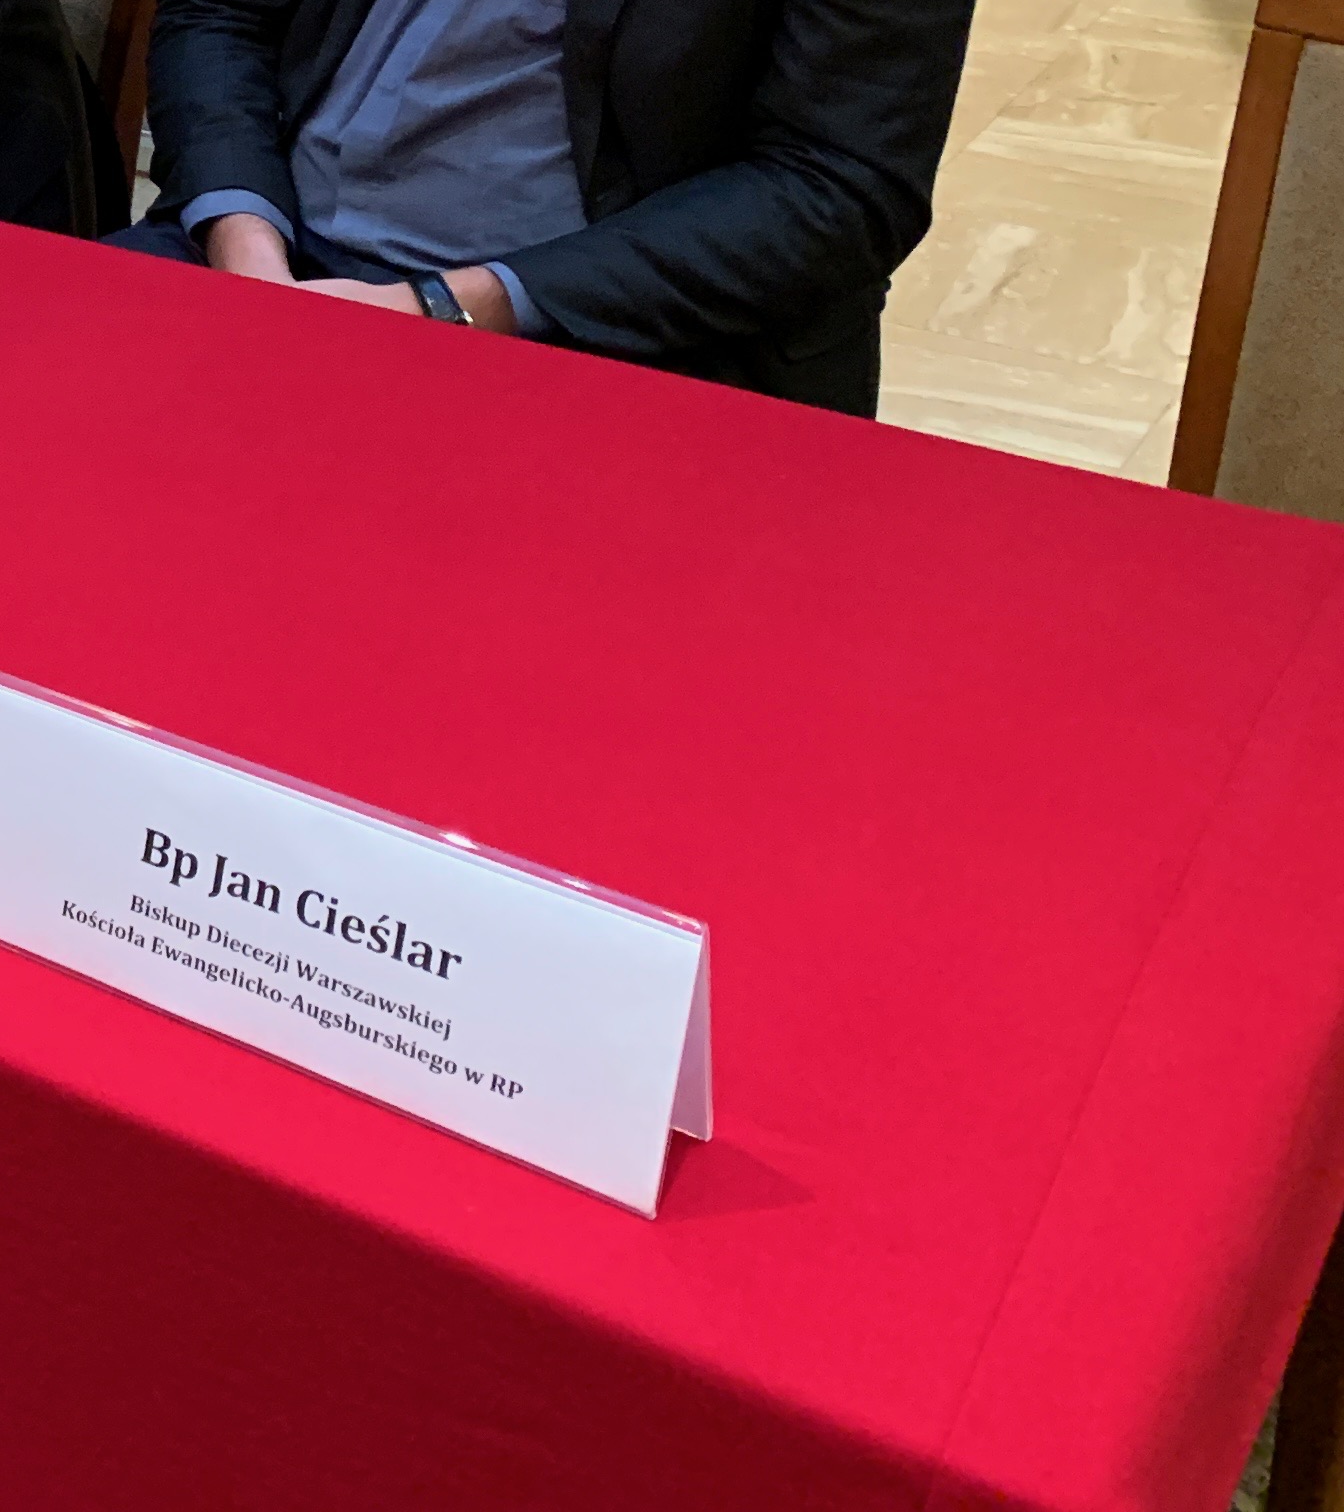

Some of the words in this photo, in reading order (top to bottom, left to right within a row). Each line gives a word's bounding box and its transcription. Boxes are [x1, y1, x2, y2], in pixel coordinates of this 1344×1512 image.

[130, 894, 201, 940] Biskup
[206, 924, 290, 974] Diecezji
[296, 958, 452, 1042] Warszawskiej
[140, 827, 199, 886] Bp
[208, 854, 281, 914] Jan
[295, 888, 463, 981] Cieślar
[61, 899, 146, 949] Kościoła
[150, 935, 458, 1075] Ewangelicko-Augsburskiego
[463, 1065, 485, 1085] w
[489, 1073, 524, 1100] RP
